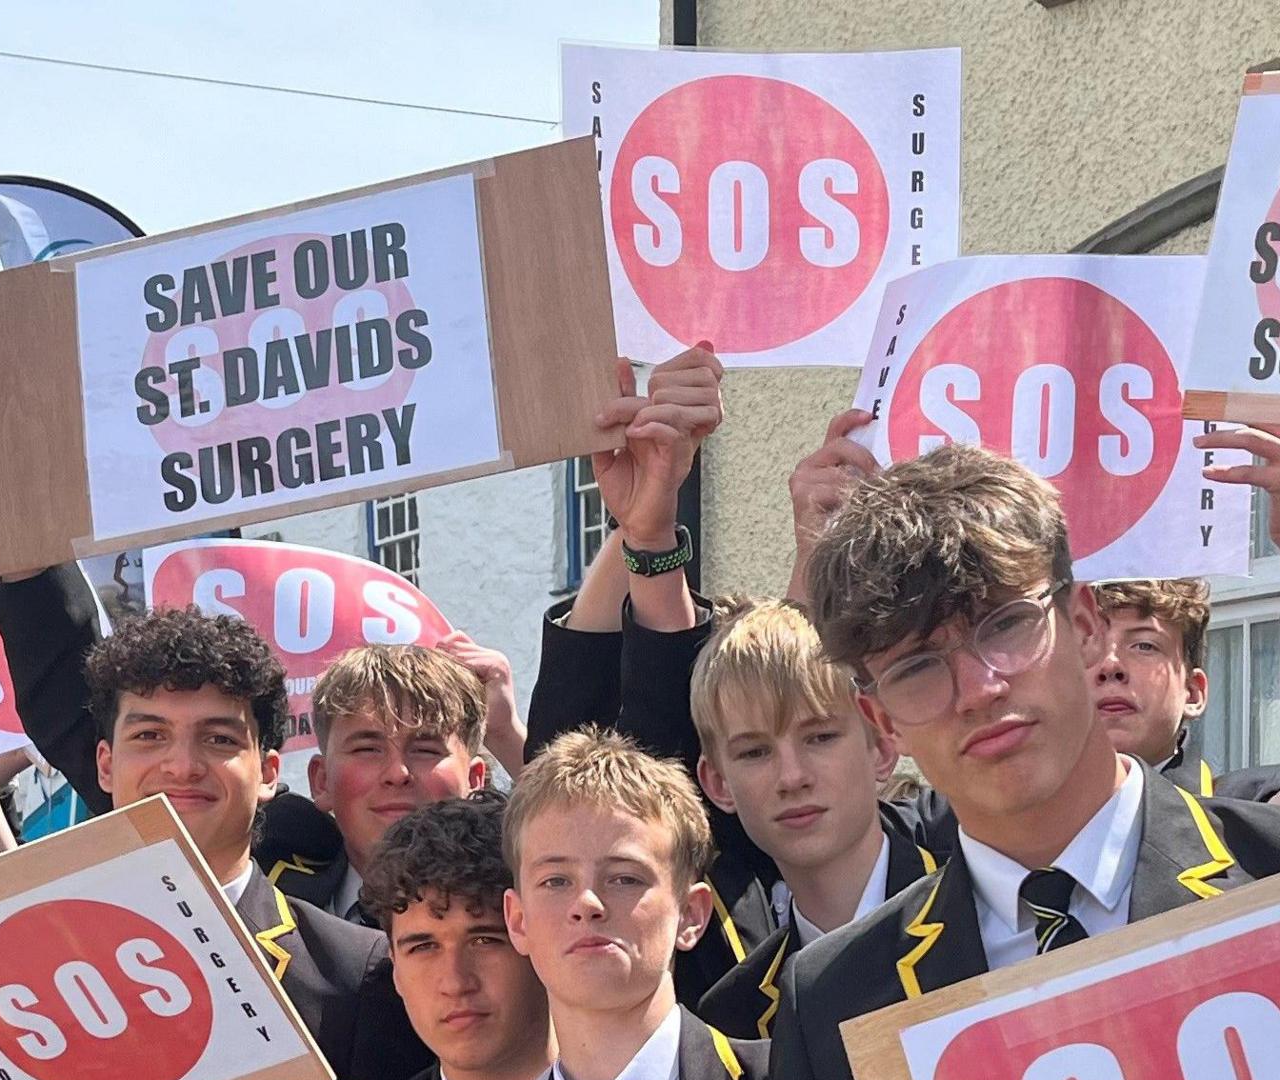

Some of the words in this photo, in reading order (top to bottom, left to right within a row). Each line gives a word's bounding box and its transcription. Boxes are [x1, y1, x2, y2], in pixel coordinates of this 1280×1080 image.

[630, 155, 861, 272] SOS
[143, 249, 280, 332] SAVE
[293, 221, 410, 300] OUR
[133, 358, 211, 426] ST.
[221, 308, 433, 408] DAVIDS
[872, 304, 907, 420] SAVE
[159, 403, 417, 514] SURGERY
[919, 363, 1156, 479] SOS
[192, 566, 423, 656] SOS
[162, 875, 271, 1043] SURGERY
